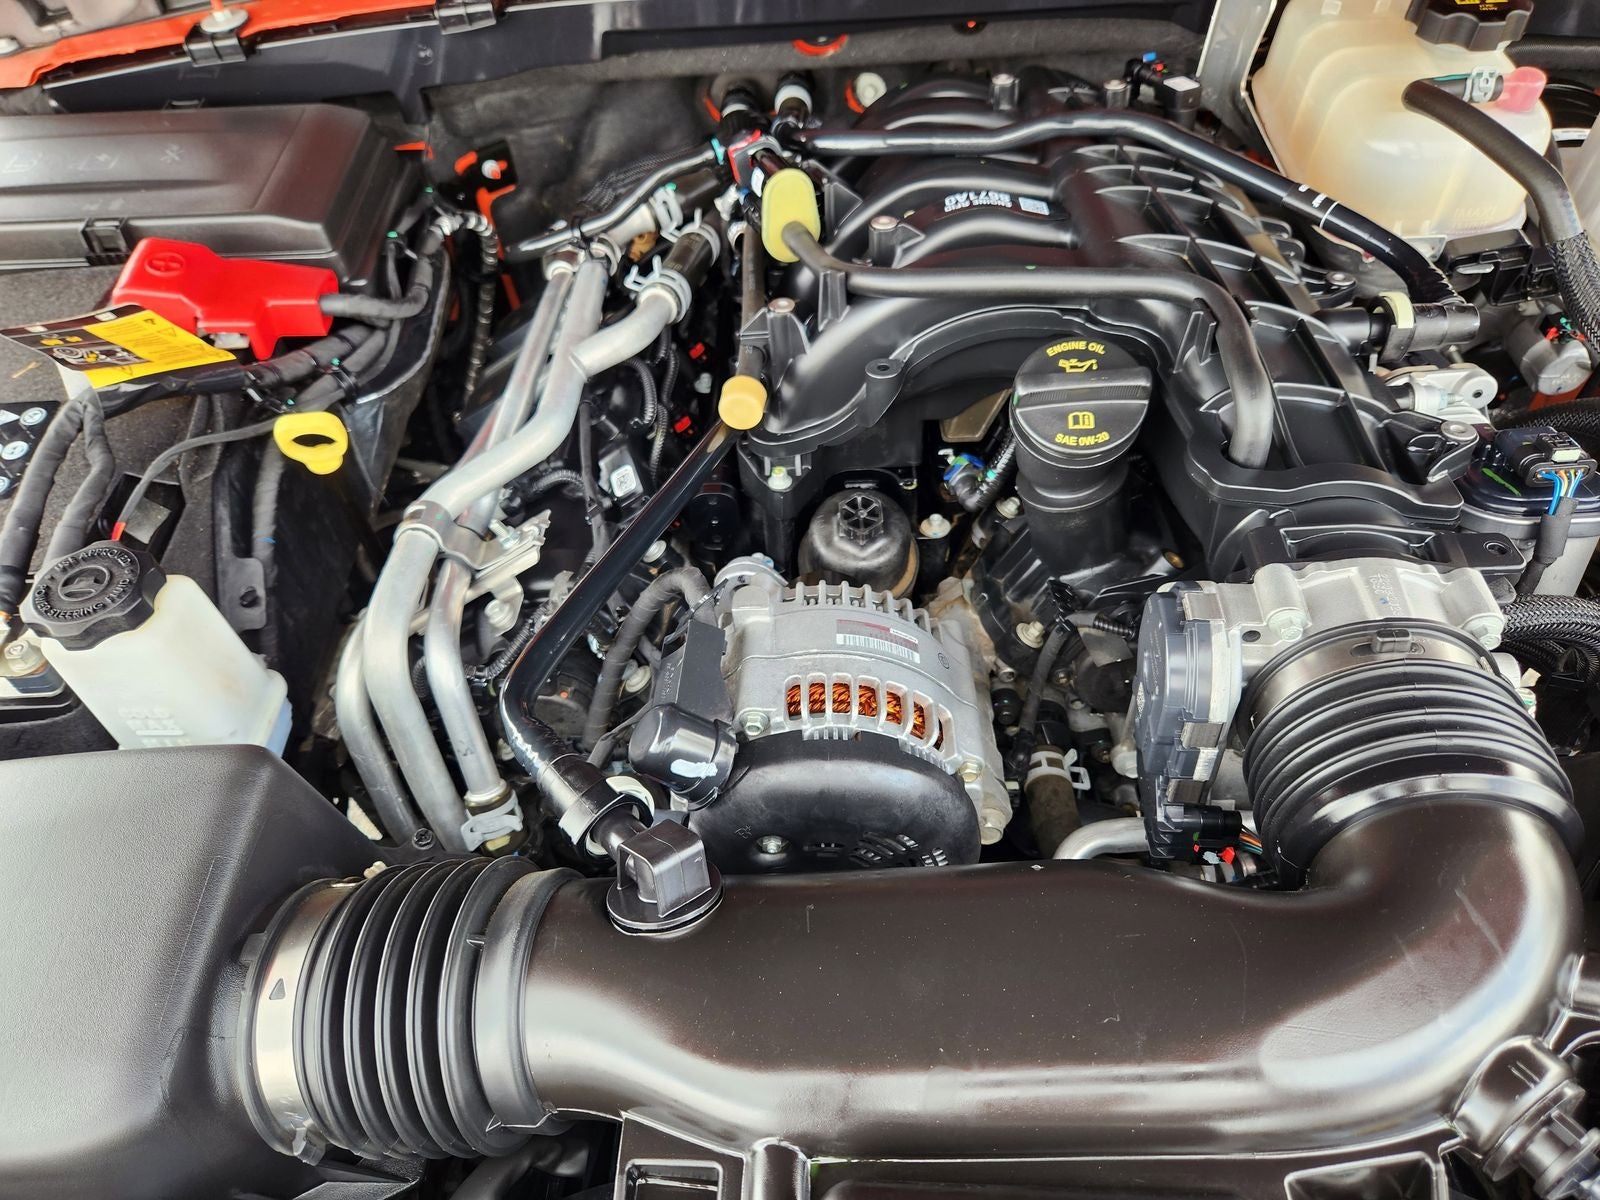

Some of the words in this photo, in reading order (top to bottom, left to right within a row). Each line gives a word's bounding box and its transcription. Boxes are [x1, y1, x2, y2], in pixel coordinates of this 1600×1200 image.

[1046, 340, 1087, 357] ENGINE
[1088, 342, 1106, 355] OIL
[1054, 433, 1078, 446] SAE
[1078, 431, 1111, 446] 0W-20
[53, 556, 77, 573] USE
[79, 547, 133, 568] APPROVED
[35, 583, 51, 616] POWER
[47, 602, 106, 620] STEERING
